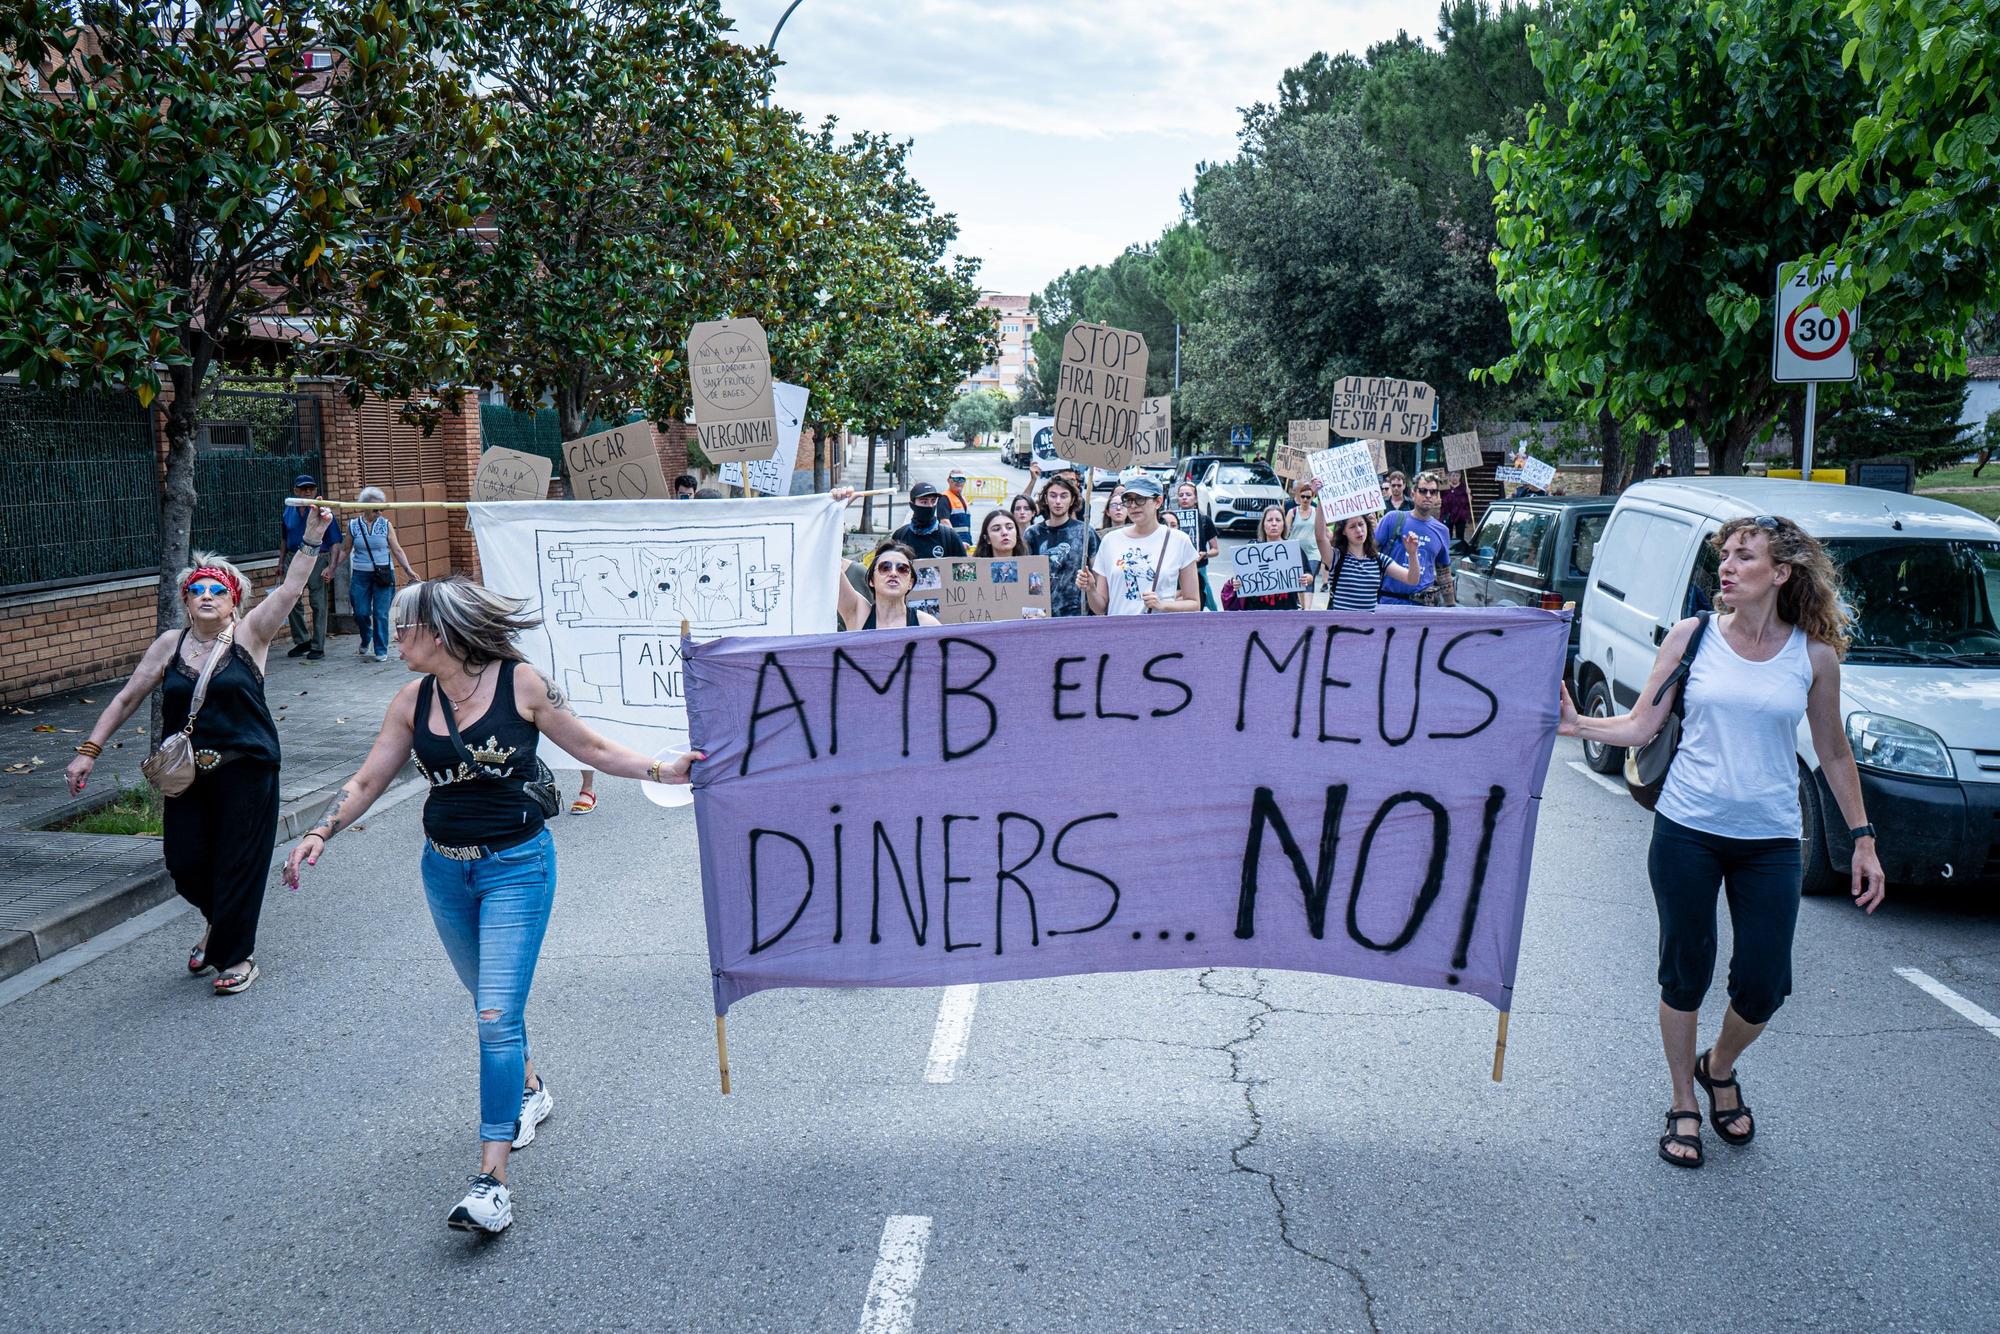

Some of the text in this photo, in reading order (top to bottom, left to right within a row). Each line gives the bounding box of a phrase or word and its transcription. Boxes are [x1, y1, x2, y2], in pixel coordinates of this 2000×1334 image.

[1799, 318, 1836, 341] 30
[1069, 325, 1141, 370] STOP
[722, 390, 745, 398] BAGES
[1060, 365, 1129, 402] FIRA DEL
[1344, 377, 1362, 394] LA
[1413, 386, 1428, 400] NI
[1334, 393, 1408, 412] ESPORT NI
[698, 420, 772, 449] VERGONYA!
[1056, 397, 1138, 451] CAÇADOR
[1331, 410, 1376, 431] FESTA
[1379, 412, 1392, 434] A
[569, 432, 627, 472] CAÇAR
[1155, 428, 1168, 453] NO
[588, 474, 612, 500] ÉS
[1235, 544, 1288, 566] CAÇA
[946, 586, 1008, 603] NO A LA
[739, 625, 1504, 777] AMB ELS MEUS
[432, 840, 482, 860] MOSCHINO
[1233, 783, 1508, 987] NO!
